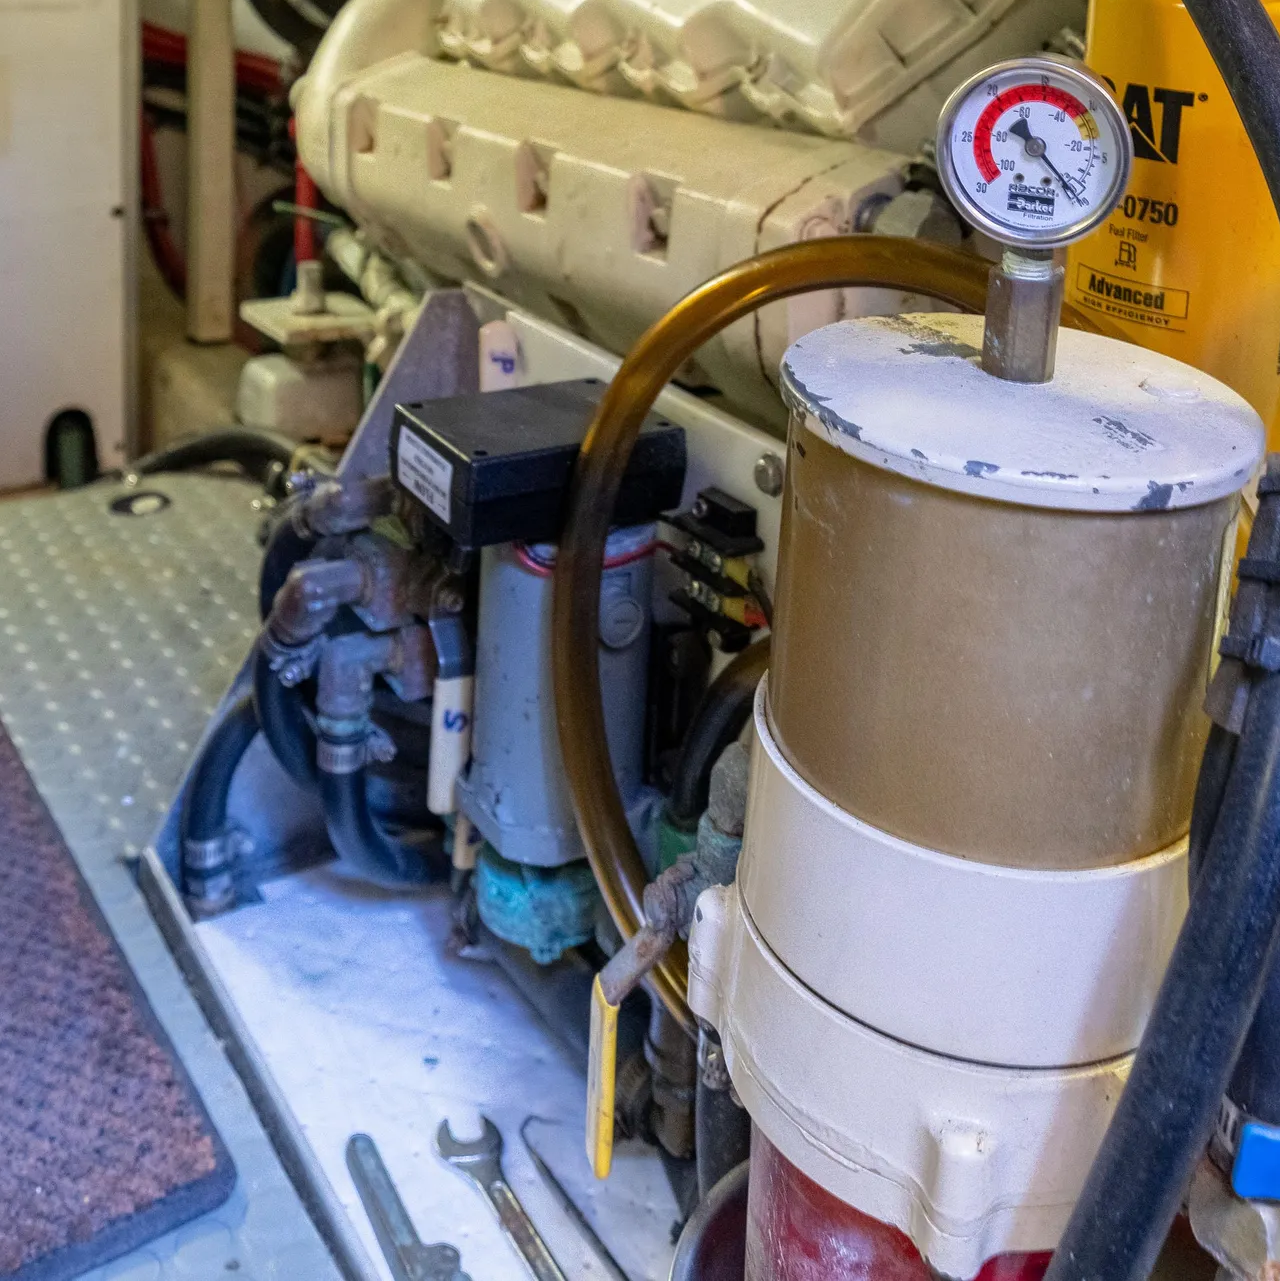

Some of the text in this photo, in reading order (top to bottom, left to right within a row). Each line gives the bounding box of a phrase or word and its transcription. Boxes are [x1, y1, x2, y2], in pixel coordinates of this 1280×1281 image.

[987, 84, 999, 96] 20
[1013, 106, 1031, 119] -60
[1048, 111, 1066, 123] -40
[961, 131, 973, 143] 25
[1065, 140, 1083, 152] -20
[1102, 152, 1108, 164] 5
[976, 182, 987, 194] 30
[1017, 197, 1054, 215] Parker
[1022, 211, 1054, 222] Filtration
[1109, 223, 1148, 243] Fuel Filter
[1088, 273, 1165, 311] Advanced
[1083, 296, 1170, 326] HIGH EFFICIENCY
